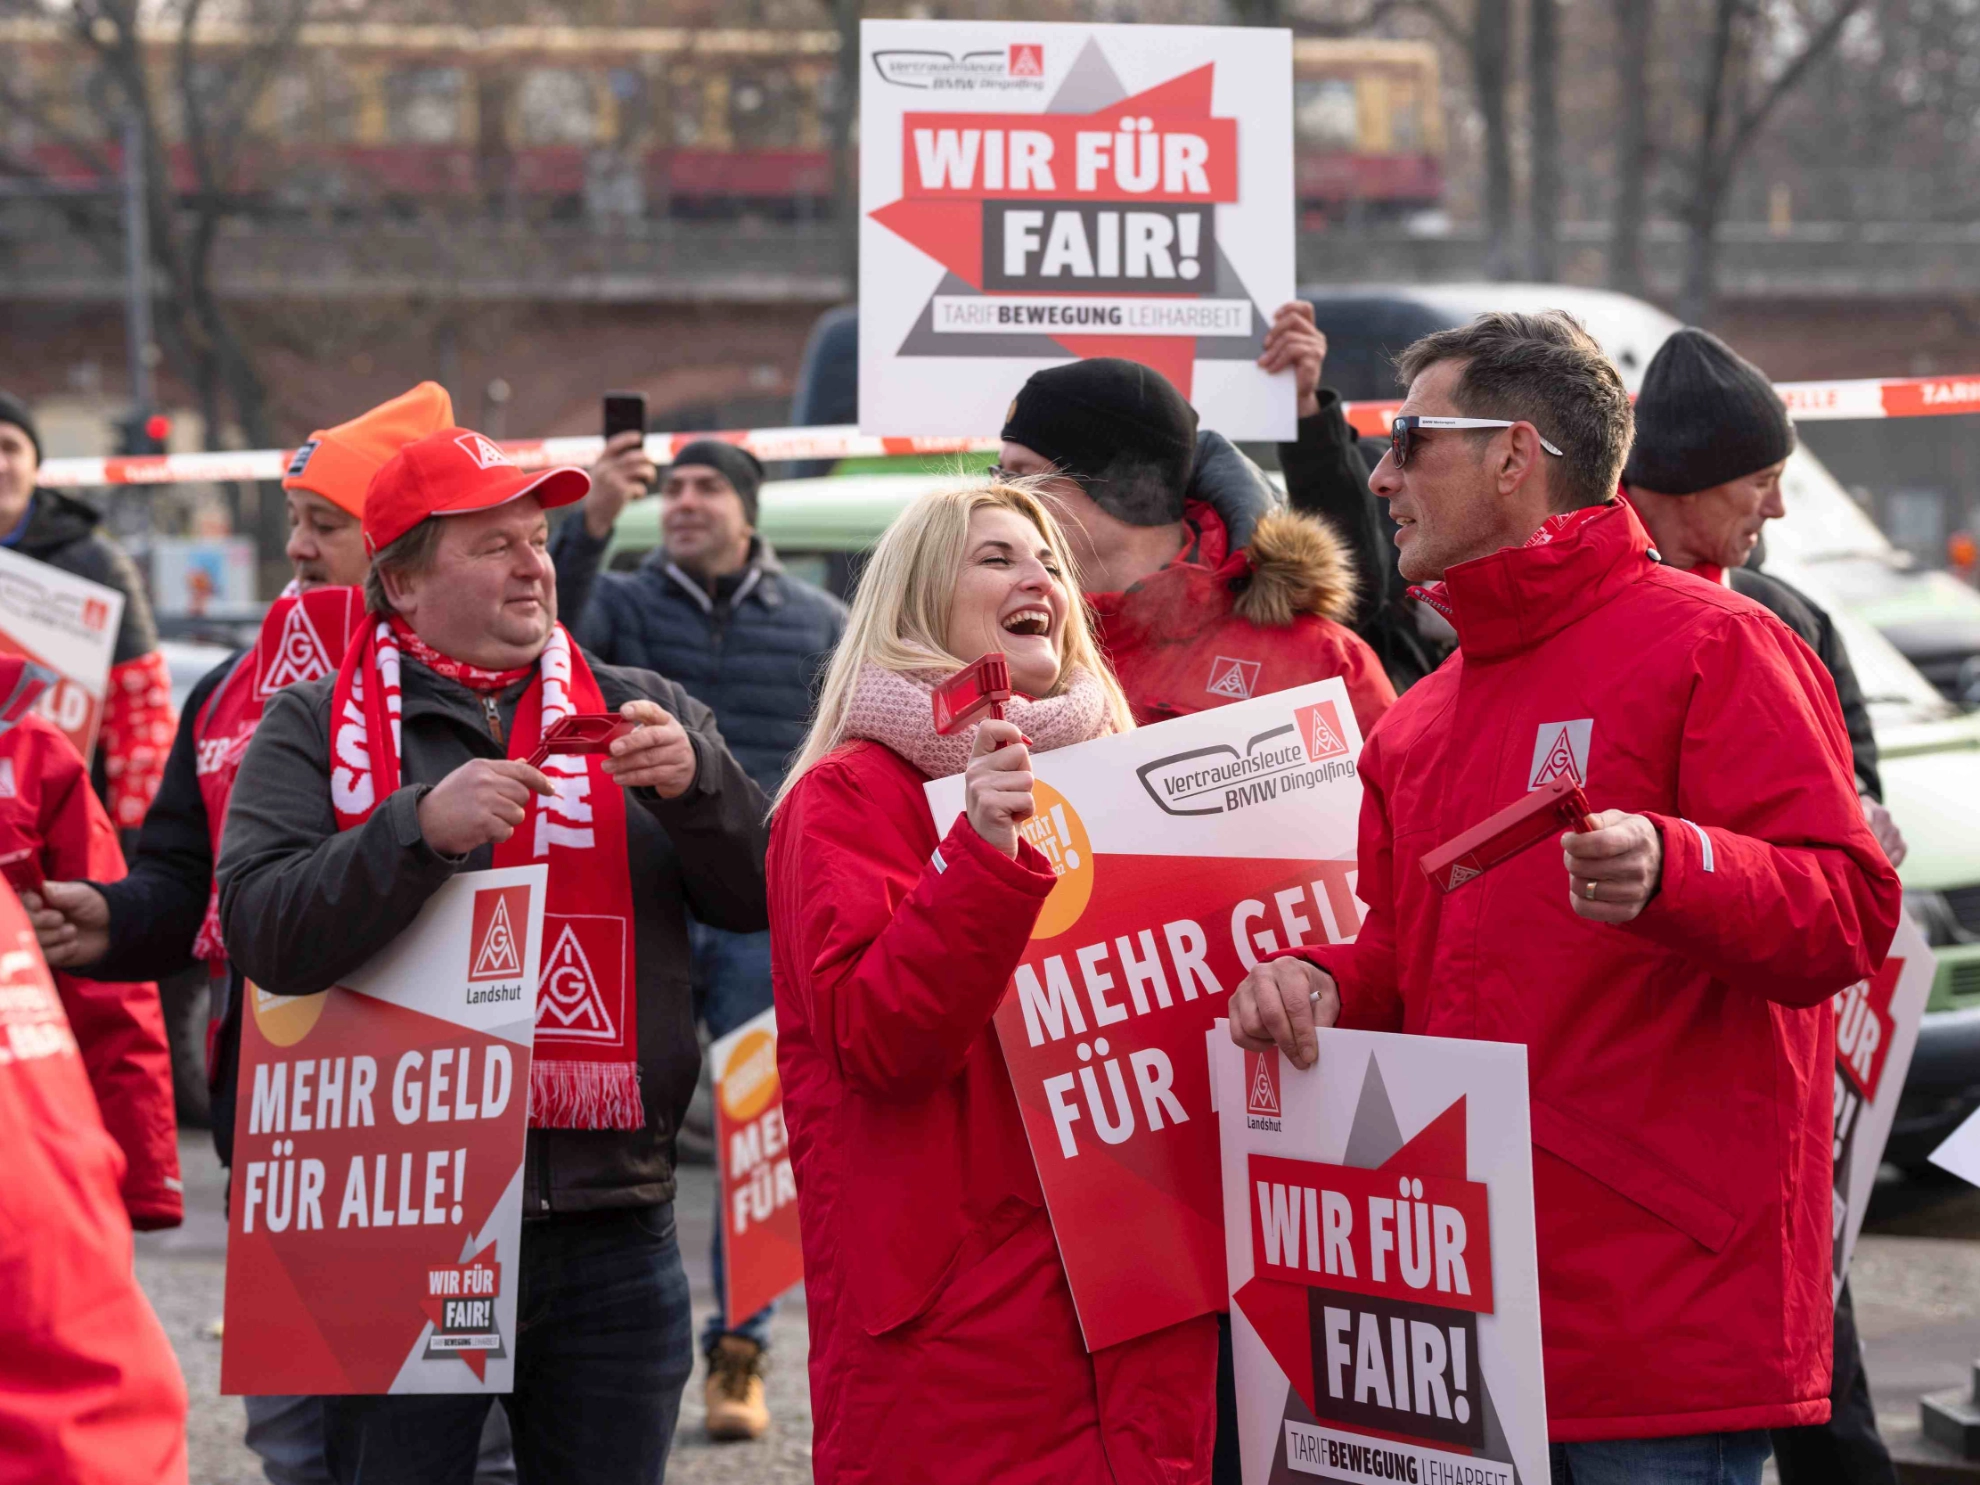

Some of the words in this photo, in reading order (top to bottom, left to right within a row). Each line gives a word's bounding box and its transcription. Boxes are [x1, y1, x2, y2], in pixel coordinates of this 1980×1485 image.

[913, 128, 1056, 190] WIR
[1075, 116, 1211, 193] FÜR
[1003, 210, 1201, 280] FAIR!
[943, 303, 1122, 326] TARIFBEWEGUNG
[1128, 306, 1242, 328] LEIHARBEIT
[1164, 745, 1302, 795] Vertrauensleute
[1225, 778, 1277, 811] BMW
[1281, 760, 1356, 793] Dingolfing
[1014, 918, 1224, 1048] MEHR
[1231, 869, 1371, 973] GEL
[466, 984, 521, 1005] Landshut
[249, 1055, 376, 1135] MEHR
[391, 1044, 513, 1125] GELD
[1043, 1037, 1190, 1159] FÜR
[1247, 1115, 1282, 1133] Landshut
[243, 1138, 326, 1234] FÜR
[338, 1148, 467, 1228] ALLE!
[733, 1162, 797, 1235] FÜR
[1256, 1180, 1358, 1279] WIR
[1368, 1176, 1472, 1296] FÜR
[428, 1270, 460, 1295] WIR
[463, 1263, 494, 1294] FÜR
[446, 1300, 491, 1328] FAIR!
[1323, 1305, 1471, 1424] FAIR!
[1291, 1431, 1418, 1485] TARIFBEWEGUNG
